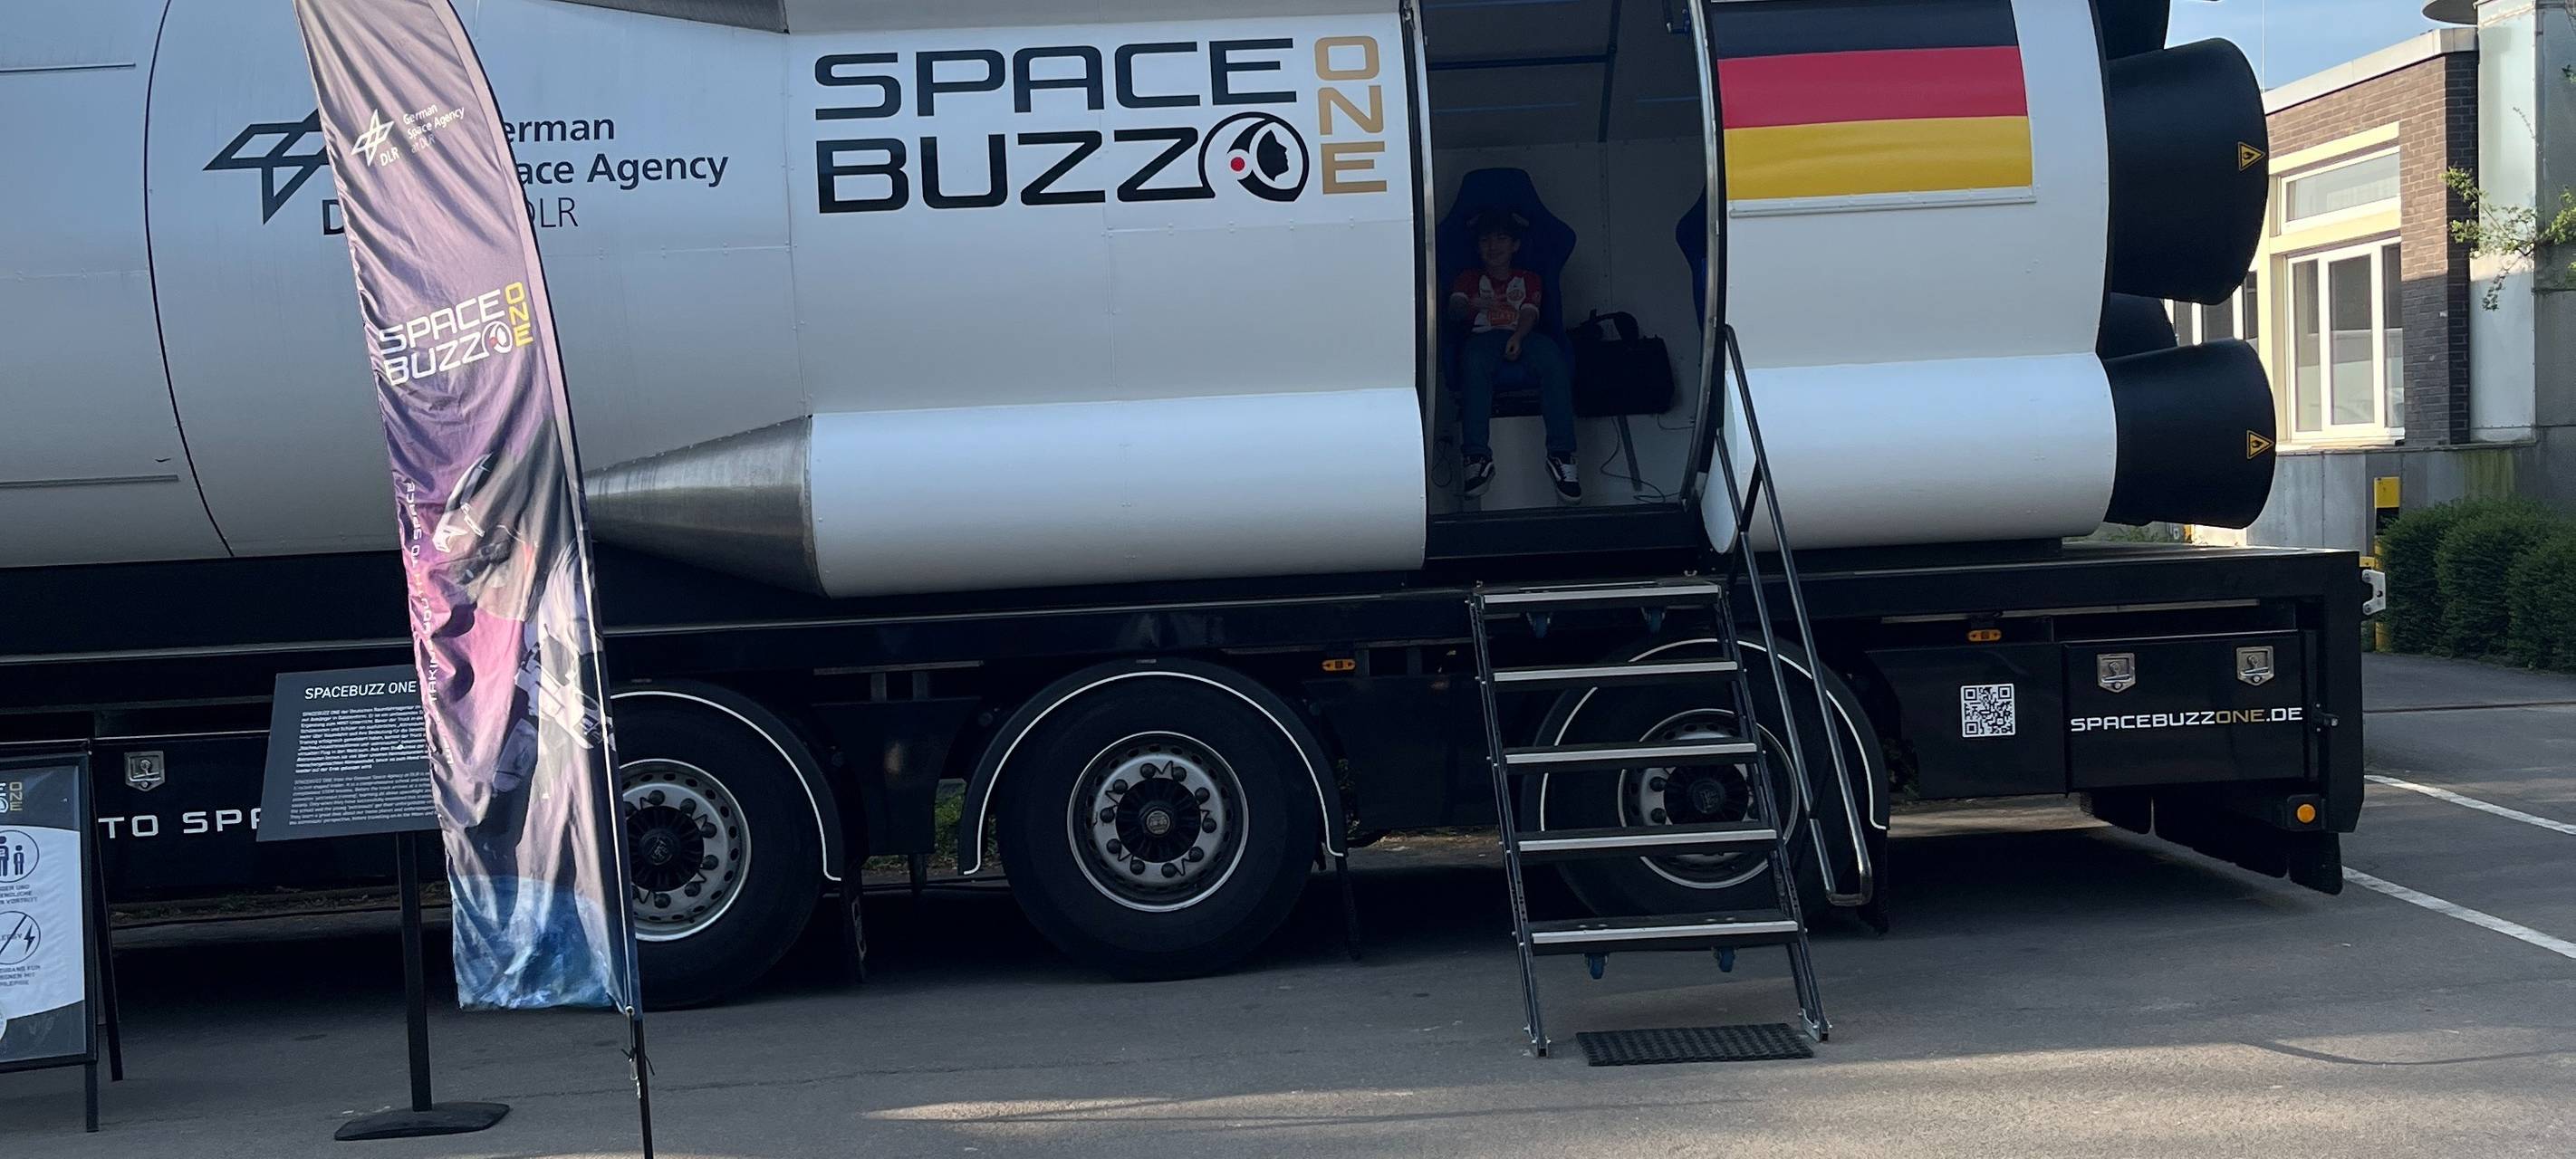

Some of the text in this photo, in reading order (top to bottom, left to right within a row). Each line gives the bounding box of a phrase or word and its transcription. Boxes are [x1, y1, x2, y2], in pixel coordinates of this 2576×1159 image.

[814, 38, 1297, 120] SPACE
[403, 104, 438, 125] German
[408, 107, 465, 139] Space Agency
[1314, 35, 1388, 196] ONE
[504, 118, 615, 143] erman
[380, 147, 400, 167] DLR
[515, 153, 729, 190] ace Agency
[379, 289, 505, 355] SPACE
[505, 282, 533, 348] ONE
[304, 681, 417, 700] SPACEBUZZ ONE
[2071, 707, 2303, 732] SPACEBUZZONE.DE
[9, 781, 23, 811] ONE
[98, 815, 159, 839] TO
